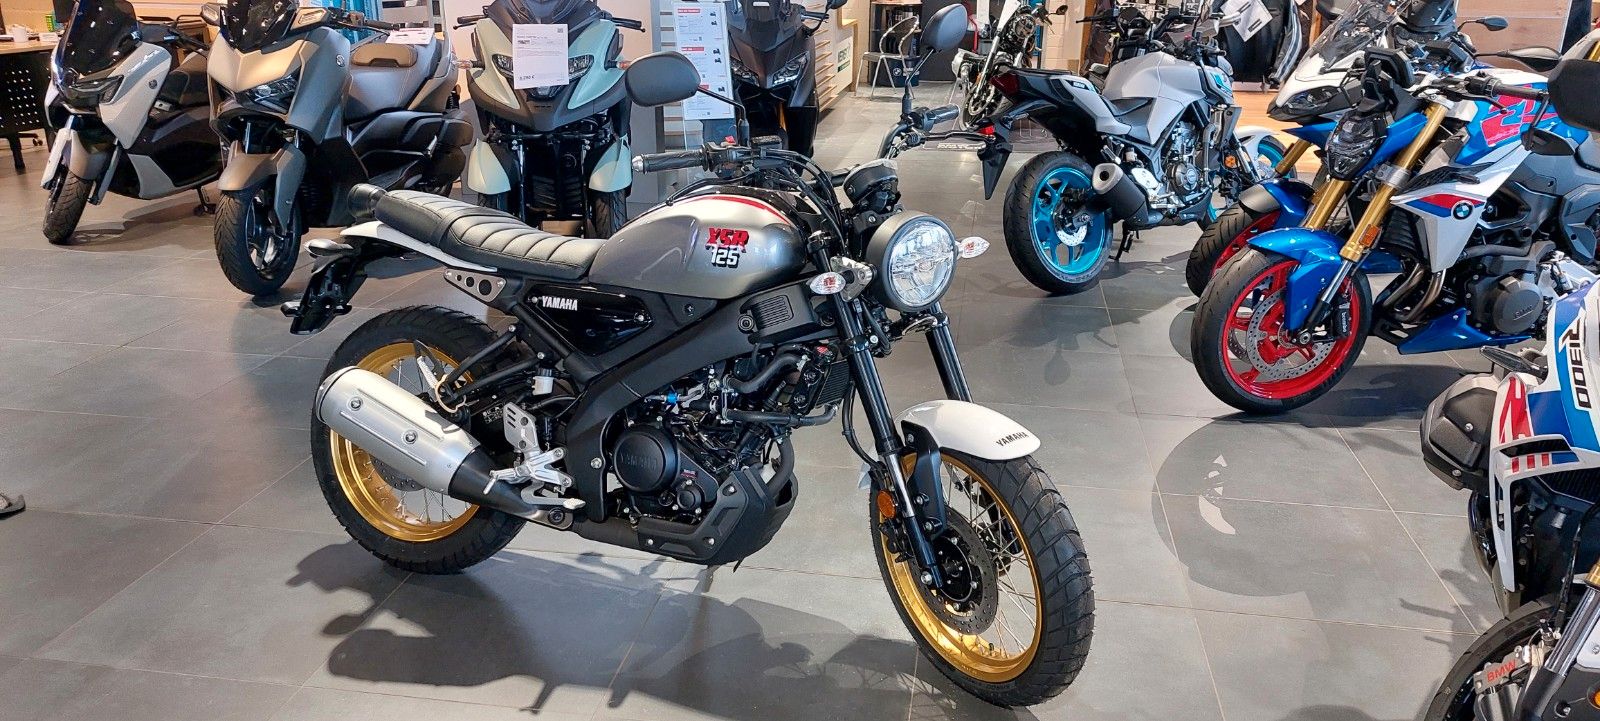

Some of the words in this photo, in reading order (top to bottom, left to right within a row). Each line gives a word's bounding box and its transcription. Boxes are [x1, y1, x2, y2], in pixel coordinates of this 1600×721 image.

[710, 246, 740, 267] 125
[542, 295, 578, 311] YAMAHA
[1561, 317, 1592, 409] R1300
[995, 431, 1029, 446] YAMAHA
[1487, 660, 1516, 682] BMW
